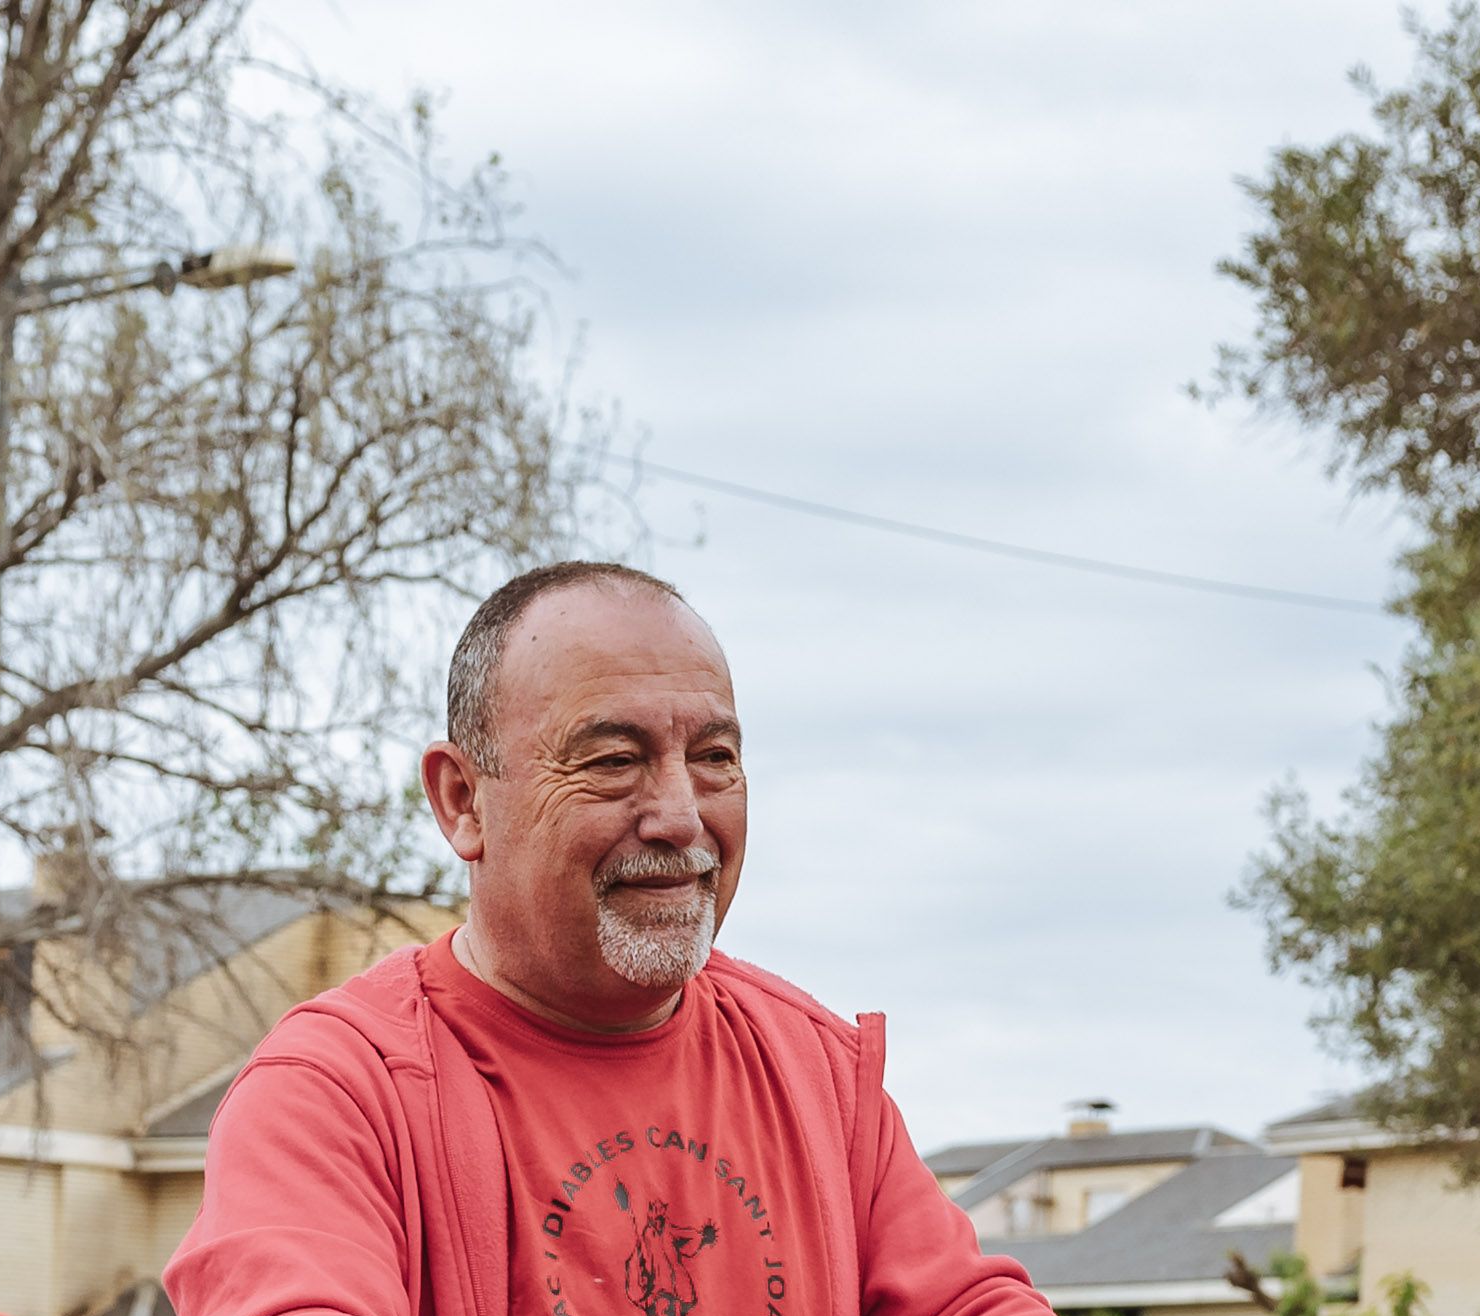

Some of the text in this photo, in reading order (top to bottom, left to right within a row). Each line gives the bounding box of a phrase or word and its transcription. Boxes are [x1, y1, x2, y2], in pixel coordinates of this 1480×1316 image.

[543, 1132, 634, 1238] DIABLES
[646, 1126, 708, 1162] CAN
[715, 1158, 774, 1241] SANT
